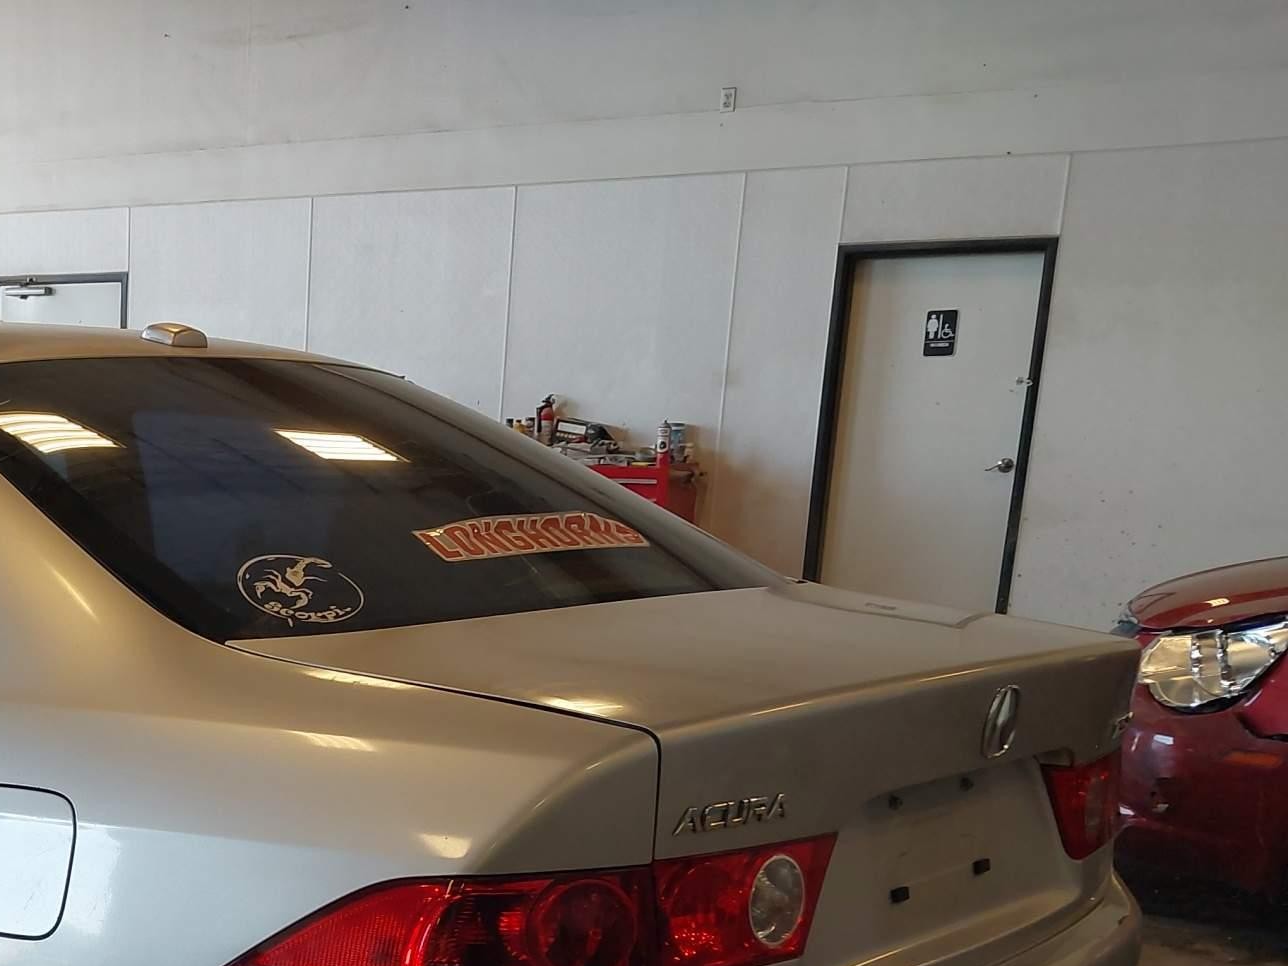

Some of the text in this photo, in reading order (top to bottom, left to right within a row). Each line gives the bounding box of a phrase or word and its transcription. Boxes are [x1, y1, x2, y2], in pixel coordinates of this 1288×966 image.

[418, 513, 646, 560] LONGHORNS
[264, 600, 352, 621] Scorpi
[672, 793, 785, 836] ACURA
